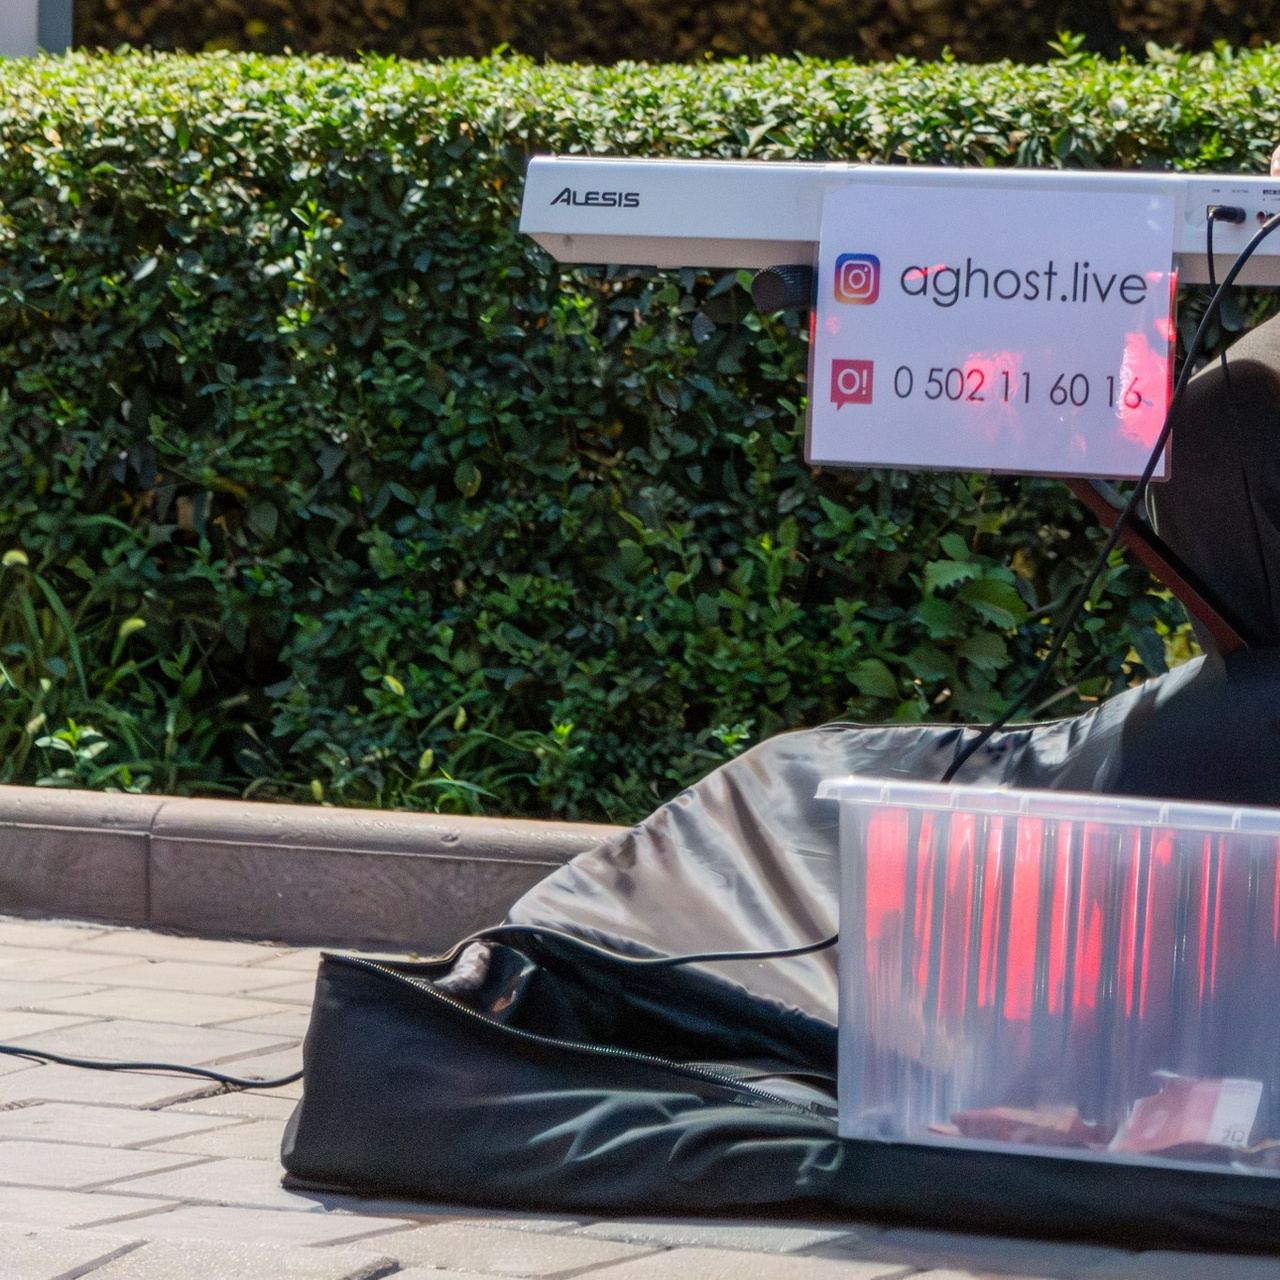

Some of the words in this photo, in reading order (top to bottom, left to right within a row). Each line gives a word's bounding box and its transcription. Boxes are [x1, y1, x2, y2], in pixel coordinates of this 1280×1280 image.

[549, 186, 640, 208] ALESIS
[900, 257, 1148, 308] aghost.live
[893, 365, 914, 399] 0
[924, 367, 986, 403] 502
[1002, 370, 1031, 405] 11
[1049, 373, 1090, 408] 60
[1106, 375, 1143, 411] 16
